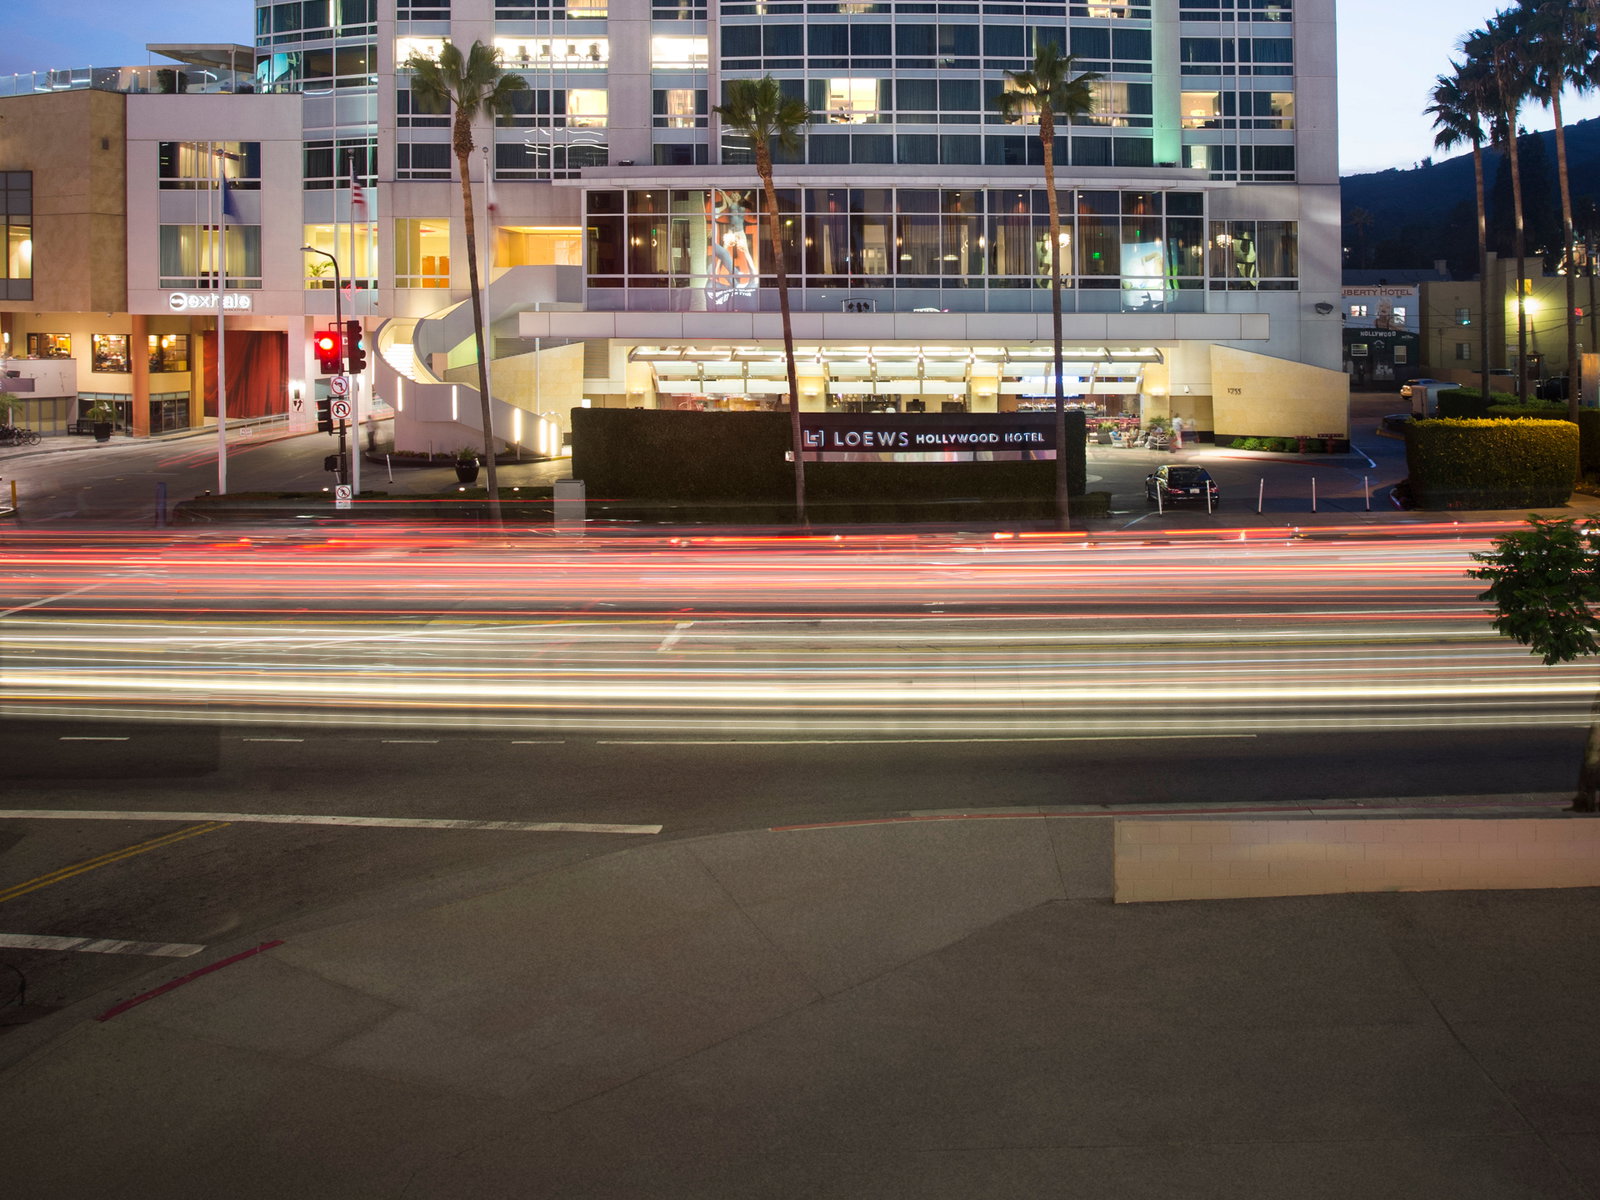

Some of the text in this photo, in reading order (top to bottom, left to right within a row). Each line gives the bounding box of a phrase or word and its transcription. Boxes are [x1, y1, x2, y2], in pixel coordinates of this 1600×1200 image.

[1380, 288, 1413, 296] HOTEL
[187, 293, 250, 308] exhale
[834, 431, 1045, 447] LOEWS HOLLYWOOD HOTEL
